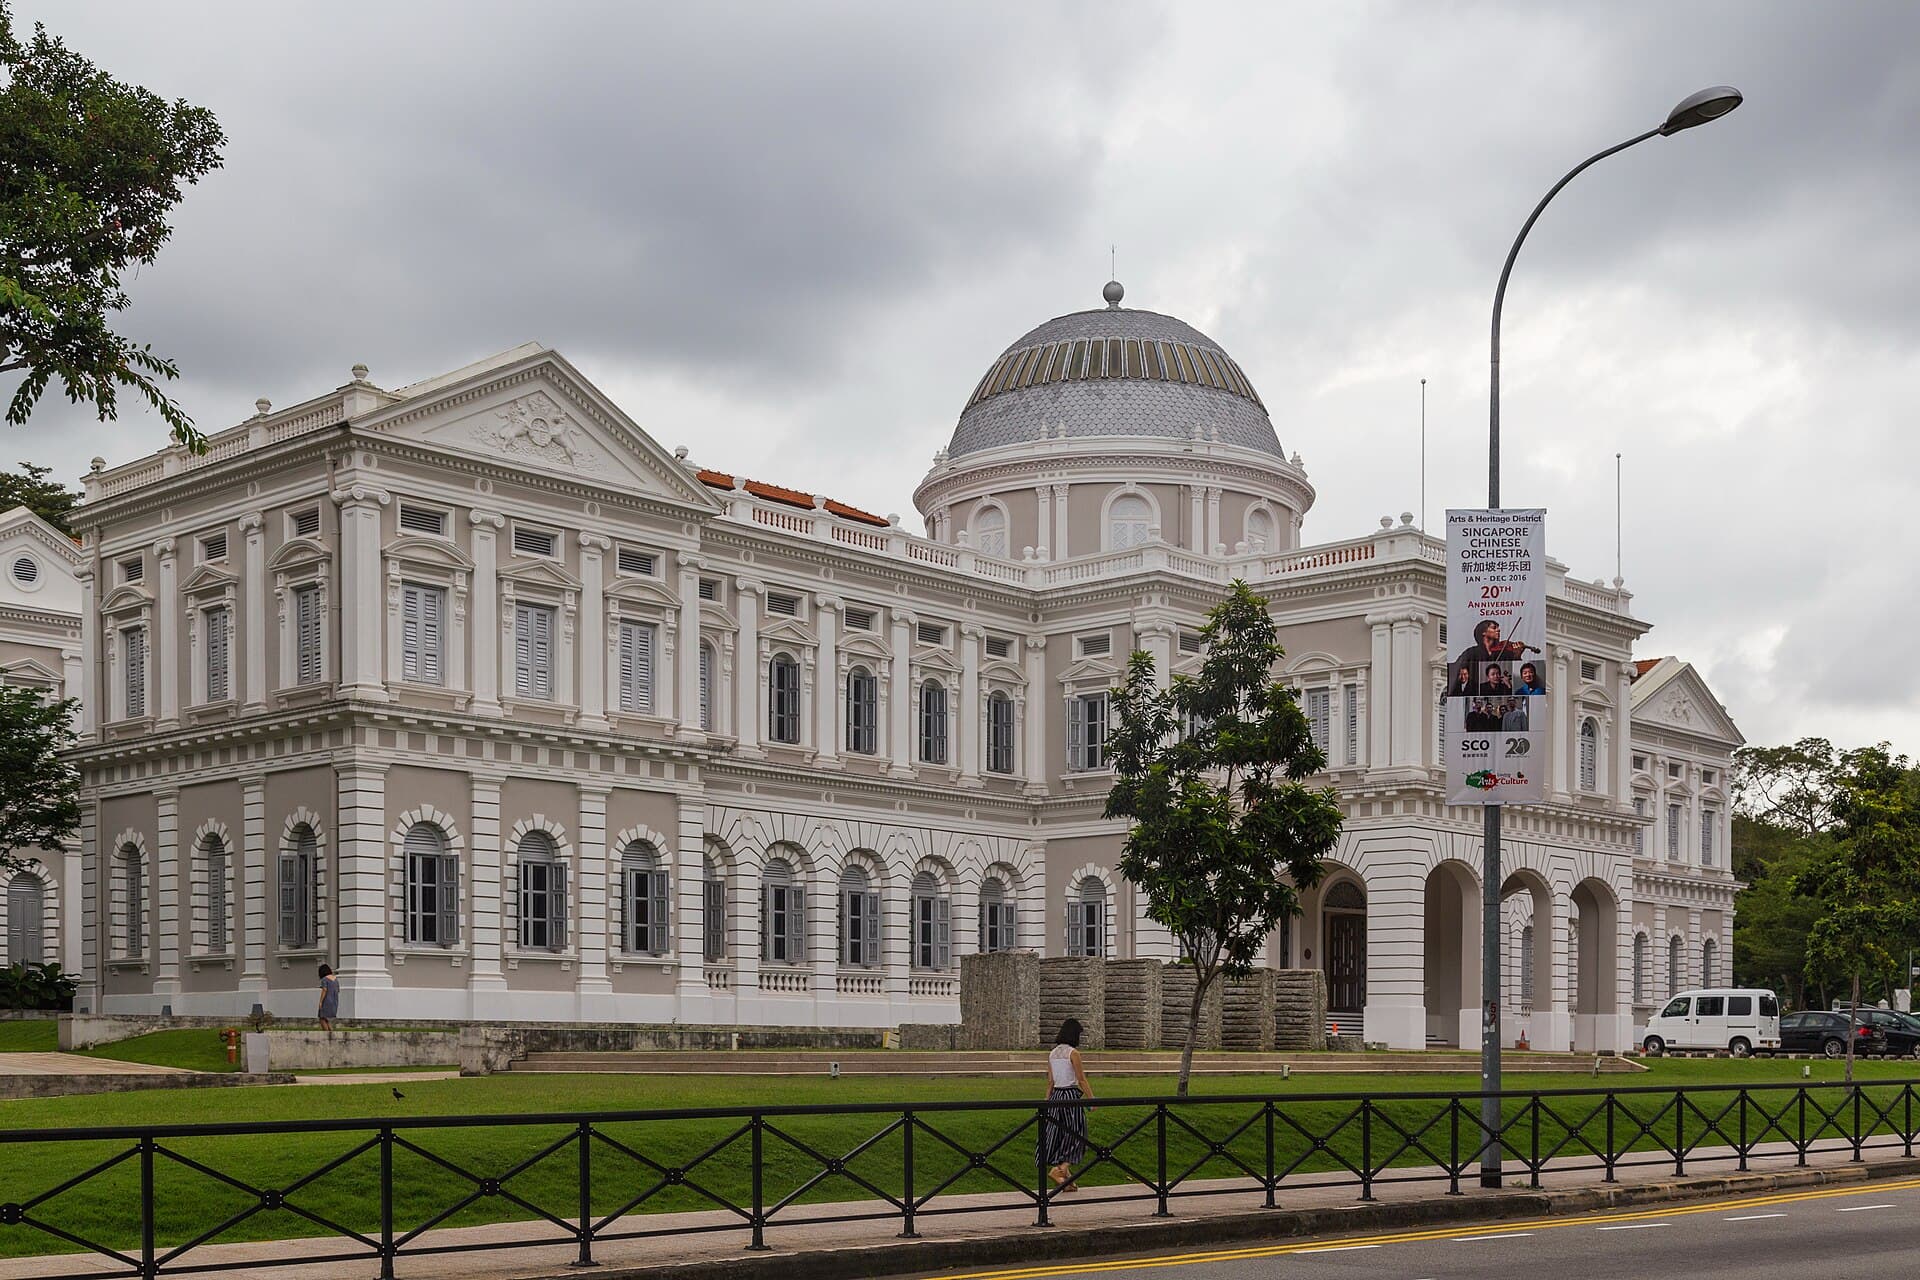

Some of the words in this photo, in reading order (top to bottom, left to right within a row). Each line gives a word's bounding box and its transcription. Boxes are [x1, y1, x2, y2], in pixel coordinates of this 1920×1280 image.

[1449, 515, 1466, 523] Arts
[1467, 515, 1474, 523] &
[1476, 515, 1511, 524] Heritage
[1512, 514, 1542, 522] District
[1462, 527, 1529, 537] SINGAPORE
[1470, 538, 1521, 548] CHINESE
[1461, 549, 1530, 559] ORCHESTRA
[1461, 560, 1531, 573] 新加坡华乐团
[1465, 576, 1481, 584] JAN
[1508, 574, 1527, 582] 2016
[1480, 585, 1512, 599] 20TH
[1461, 739, 1490, 751] SCO
[1500, 777, 1529, 785] Culture
